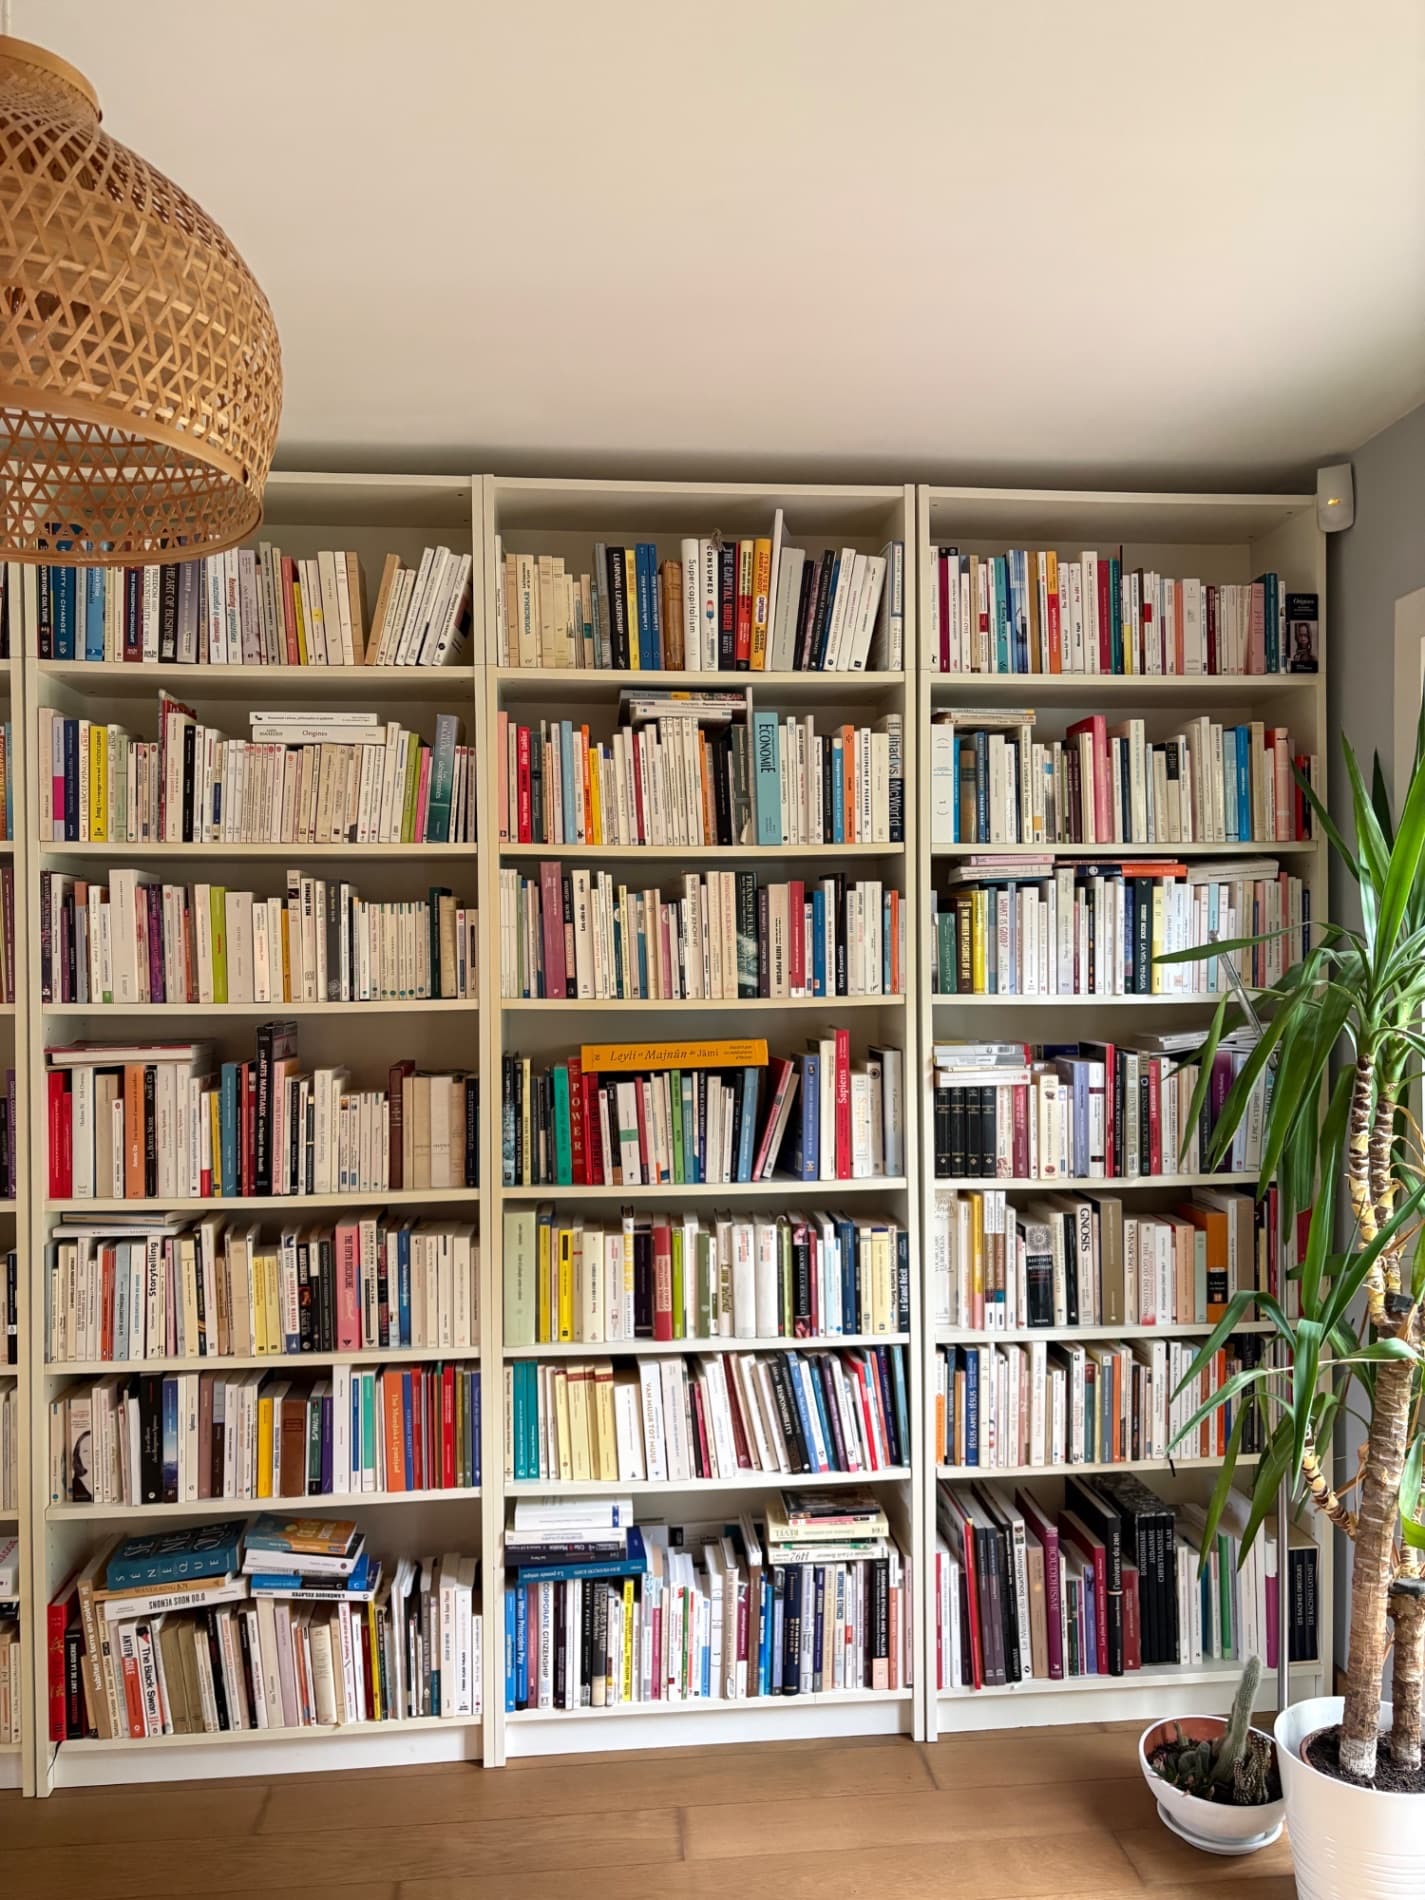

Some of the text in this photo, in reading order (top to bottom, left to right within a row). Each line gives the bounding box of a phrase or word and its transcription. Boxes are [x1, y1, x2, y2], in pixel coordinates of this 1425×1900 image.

[166, 567, 177, 594] HEART
[706, 545, 714, 595] CONSUMED
[722, 548, 734, 631] THE CAPITAL ORDER
[614, 553, 624, 634] LEARNING LEADERSHIP
[687, 559, 698, 634] Supercapitalism
[889, 734, 902, 761] Jihad
[890, 781, 901, 827] McWorld
[746, 875, 756, 912] FRANCIS
[960, 910, 970, 918] THE
[999, 898, 1008, 918] WHAT
[960, 938, 970, 962] PLEASURES
[610, 1049, 636, 1062] Leyli
[259, 1078, 267, 1117] MARTIAUX
[837, 1069, 848, 1104] Sapiens
[572, 1084, 582, 1150] POWER
[1080, 1208, 1090, 1252] GNOSIS
[148, 1242, 158, 1297] Storytelling
[345, 1234, 353, 1289] THE FIFTH DISCIPLINE
[900, 1285, 908, 1304] Grand
[776, 1384, 792, 1435] RESPONSIBILITY
[1016, 1548, 1026, 1598] bouddhisme
[1112, 1532, 1120, 1590] l'univers du zen
[542, 1582, 550, 1630] CORPORATE
[836, 1571, 844, 1620] WORKING ETHICS
[88, 1634, 98, 1652] terre
[91, 1654, 98, 1662] la
[92, 1663, 102, 1690] habiter
[142, 1646, 156, 1714] The Black Swan
